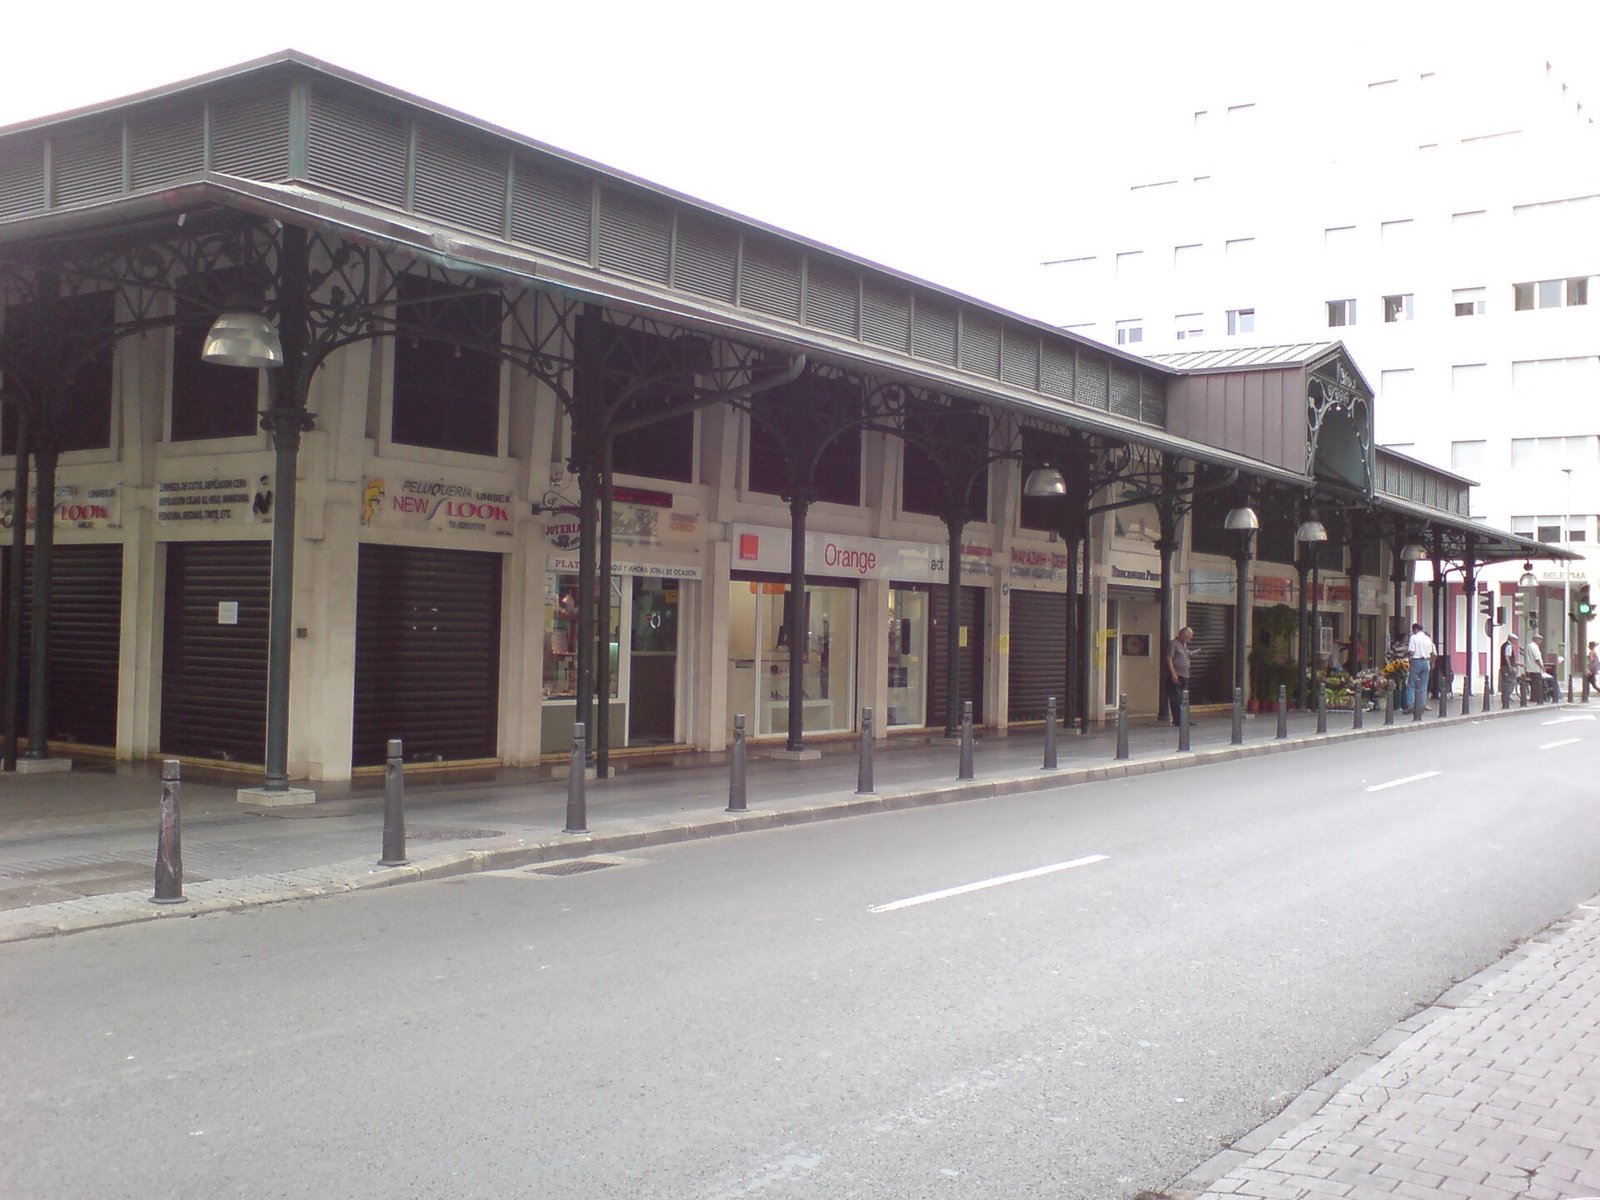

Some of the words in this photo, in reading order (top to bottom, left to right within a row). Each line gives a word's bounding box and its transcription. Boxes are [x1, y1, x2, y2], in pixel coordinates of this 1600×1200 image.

[402, 480, 472, 498] PELUQUERIA
[476, 492, 512, 503] UNISEX
[393, 496, 430, 514] NEW
[447, 501, 509, 521] LOOK
[824, 543, 876, 574] Orange
